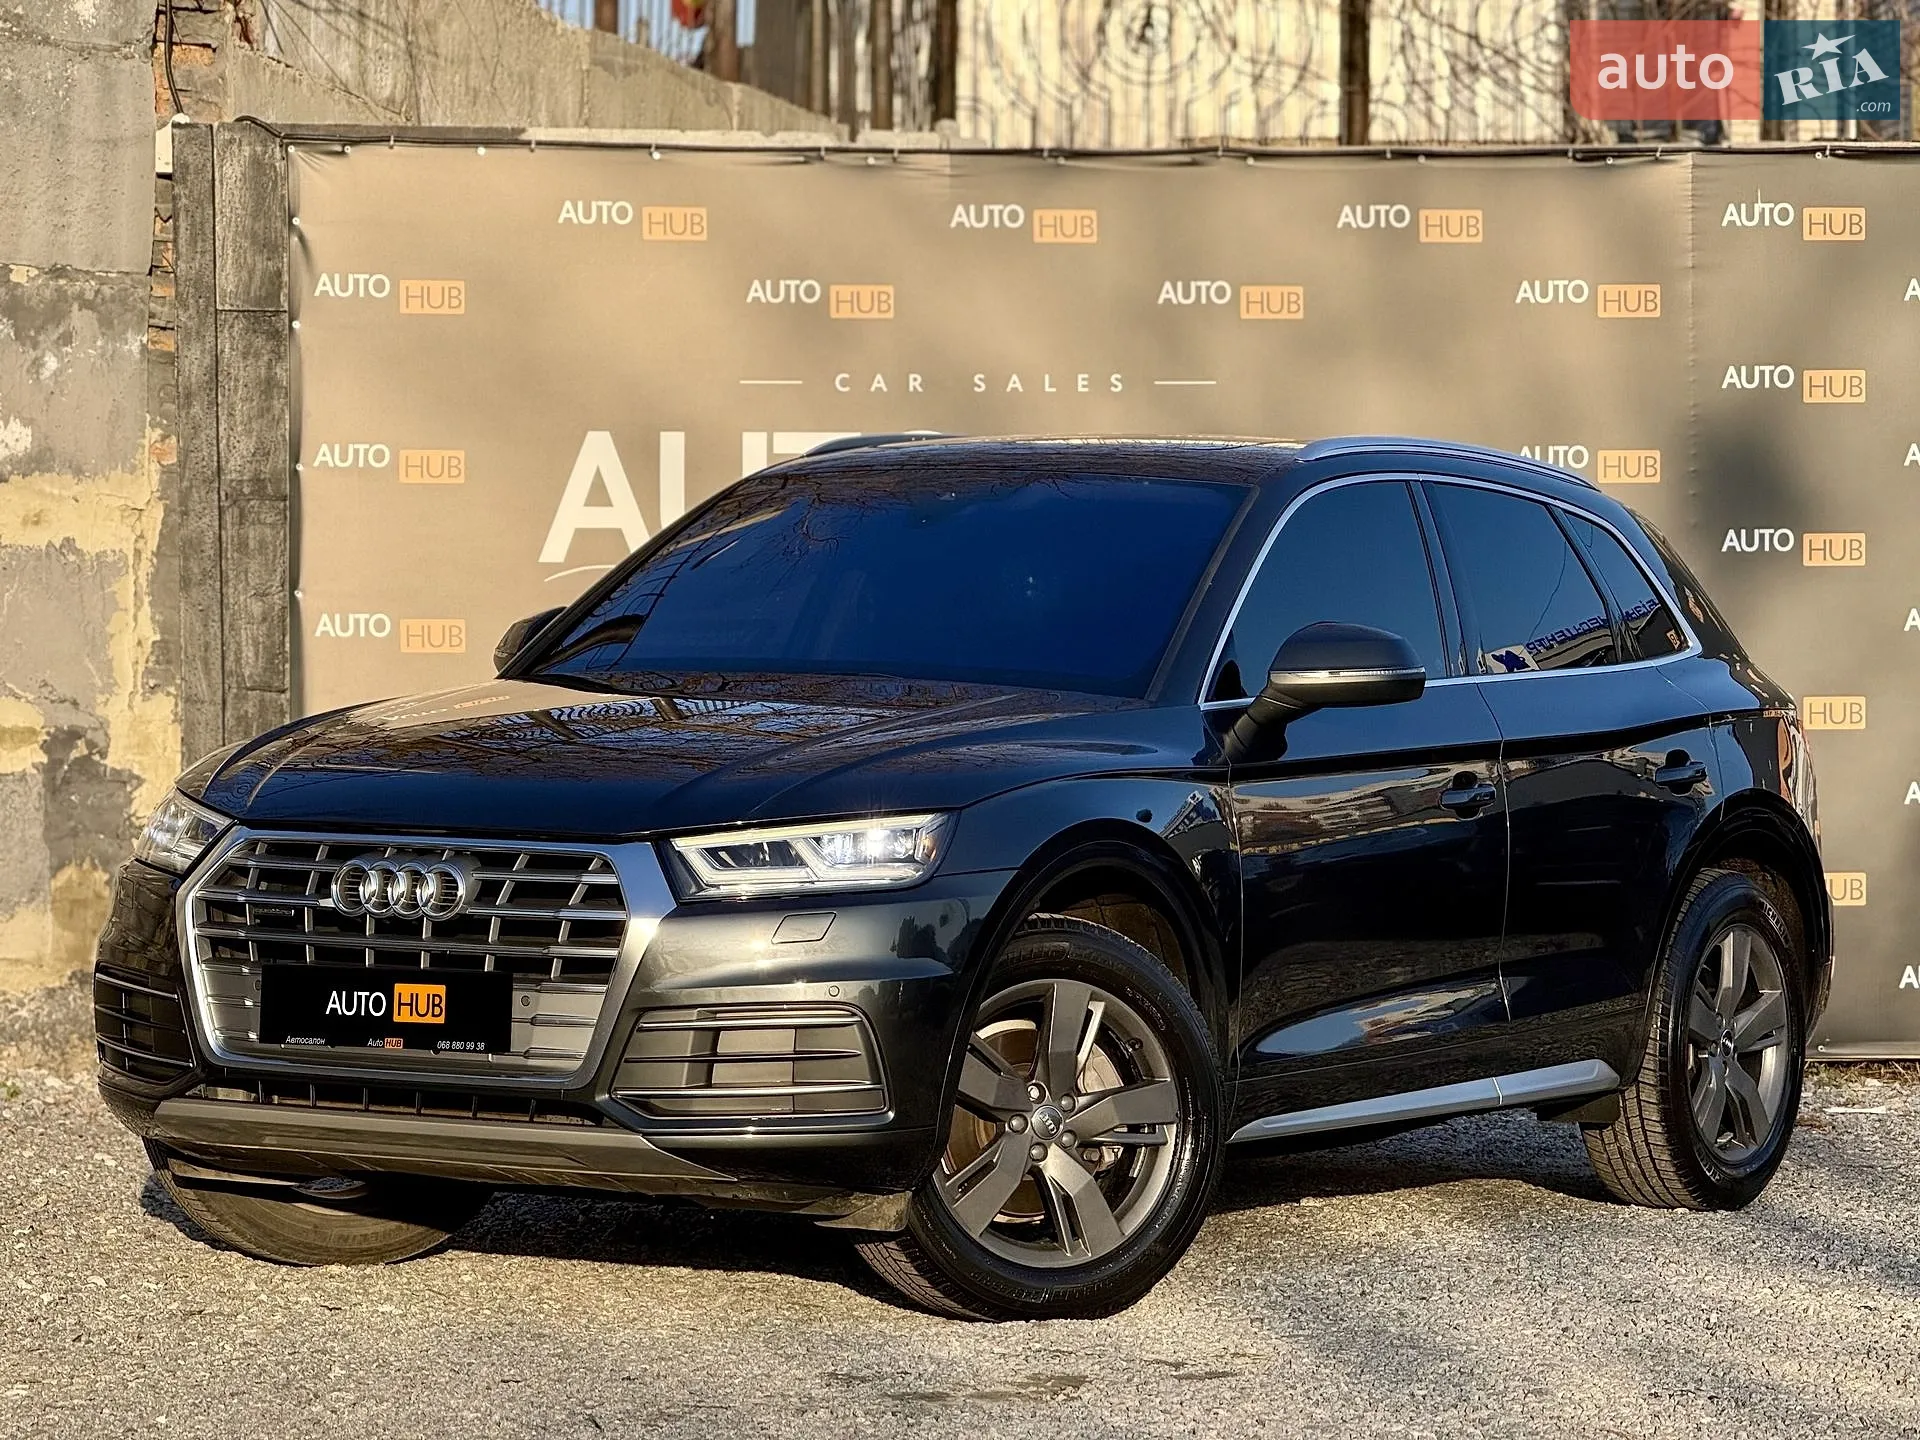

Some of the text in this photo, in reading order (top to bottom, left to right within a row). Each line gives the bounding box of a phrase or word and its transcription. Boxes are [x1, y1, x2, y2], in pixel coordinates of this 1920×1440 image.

[558, 201, 704, 236] AUTO HUB
[951, 204, 1094, 238] AUTO HUB
[1337, 204, 1480, 238] AUTO HUB
[1721, 203, 1863, 236] AUTO HUB
[314, 273, 462, 309] AUTO HUB
[746, 280, 891, 314] AUTO HUB
[1158, 281, 1301, 315] AUTO HUB
[1515, 280, 1658, 313] AUTO HUB
[834, 373, 1123, 392] CAR SALES
[1721, 365, 1863, 398] AUTO HUB
[313, 444, 462, 479] AUTO HUB
[1603, 456, 1658, 478] HUB
[1721, 529, 1863, 562] AUTO HUB
[315, 614, 463, 649] AUTO HUB
[1808, 702, 1863, 725] HUB
[1830, 878, 1864, 901] UB
[326, 990, 444, 1018] AUTO HUB
[285, 1035, 325, 1045] Автосалон
[367, 1038, 402, 1048] Auto HUB
[437, 1040, 485, 1051] 068 880 99 38
